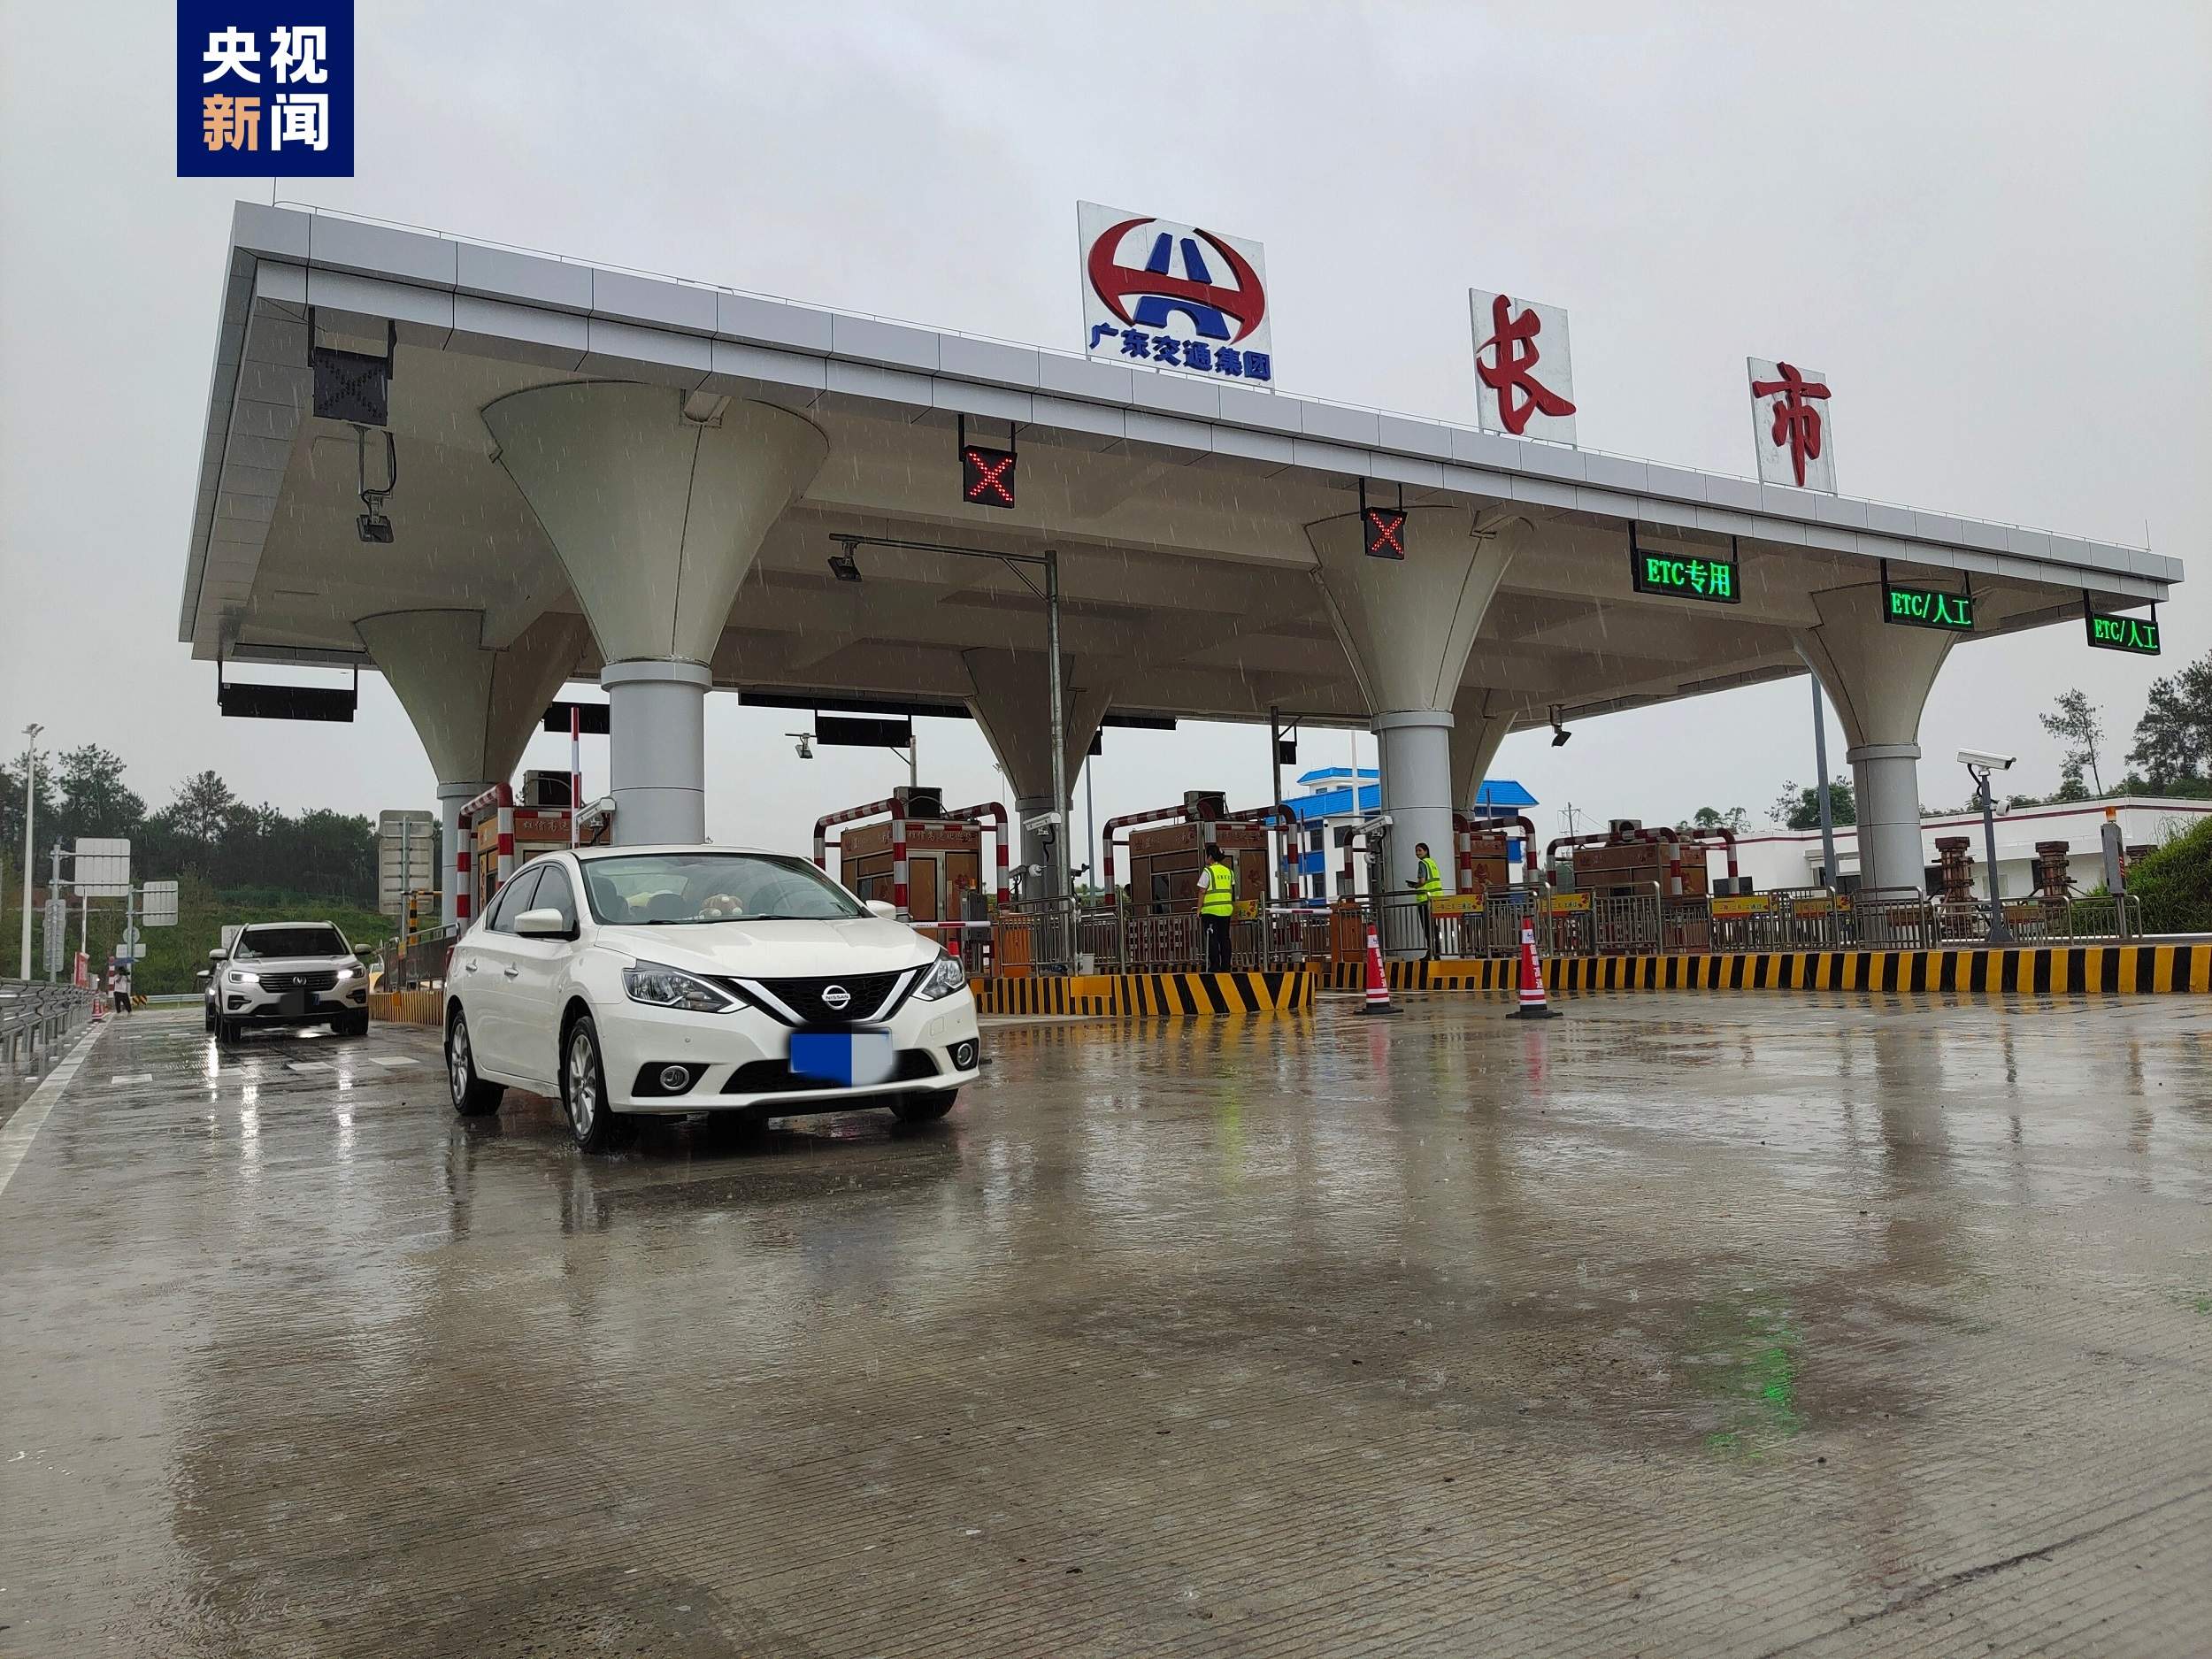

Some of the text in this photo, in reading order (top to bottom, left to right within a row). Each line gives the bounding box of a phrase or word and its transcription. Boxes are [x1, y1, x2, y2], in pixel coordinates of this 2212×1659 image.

[1089, 322, 1271, 381] 广东交通集团
[1477, 294, 1577, 435] 长
[1752, 361, 1832, 487] 市
[1647, 558, 1731, 596] ETC专用
[1891, 592, 1972, 625] ETC/人工
[2093, 618, 2159, 649] ETC/人工
